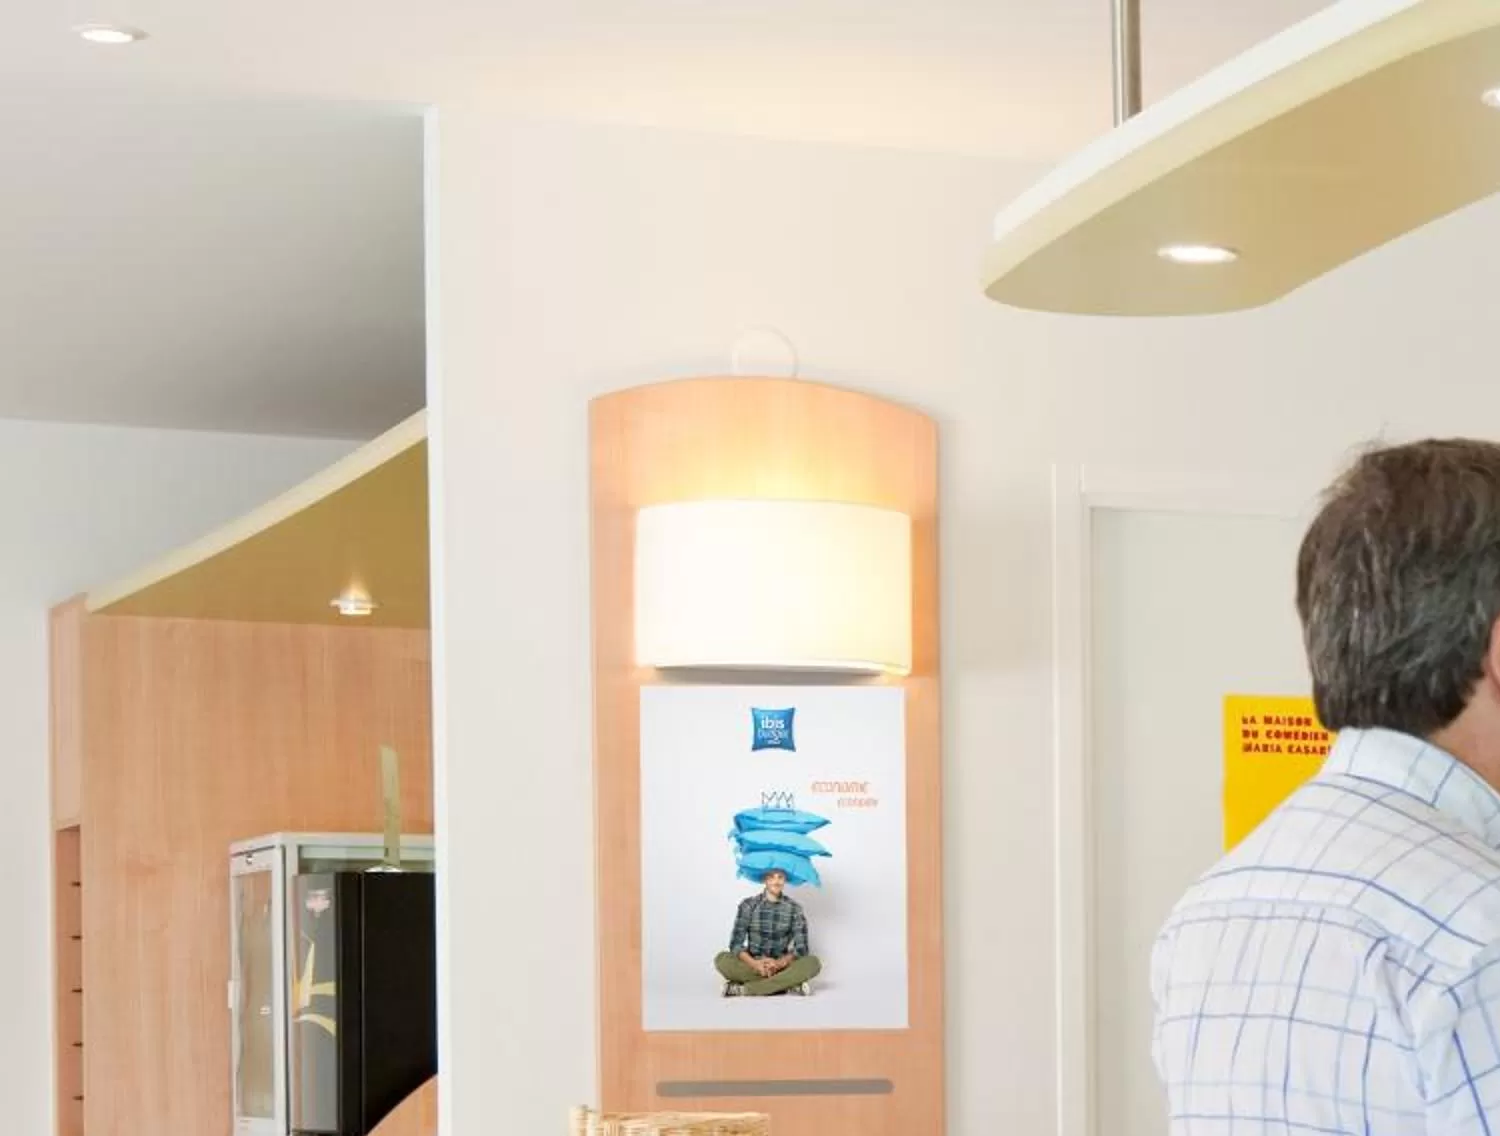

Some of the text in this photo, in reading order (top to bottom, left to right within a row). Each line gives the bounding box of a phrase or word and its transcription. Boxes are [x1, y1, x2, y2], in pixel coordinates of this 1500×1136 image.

[761, 715, 785, 729] ibis
[1242, 715, 1313, 726] LA MAISON
[1242, 729, 1259, 739] DU
[1243, 743, 1283, 754] MARIA
